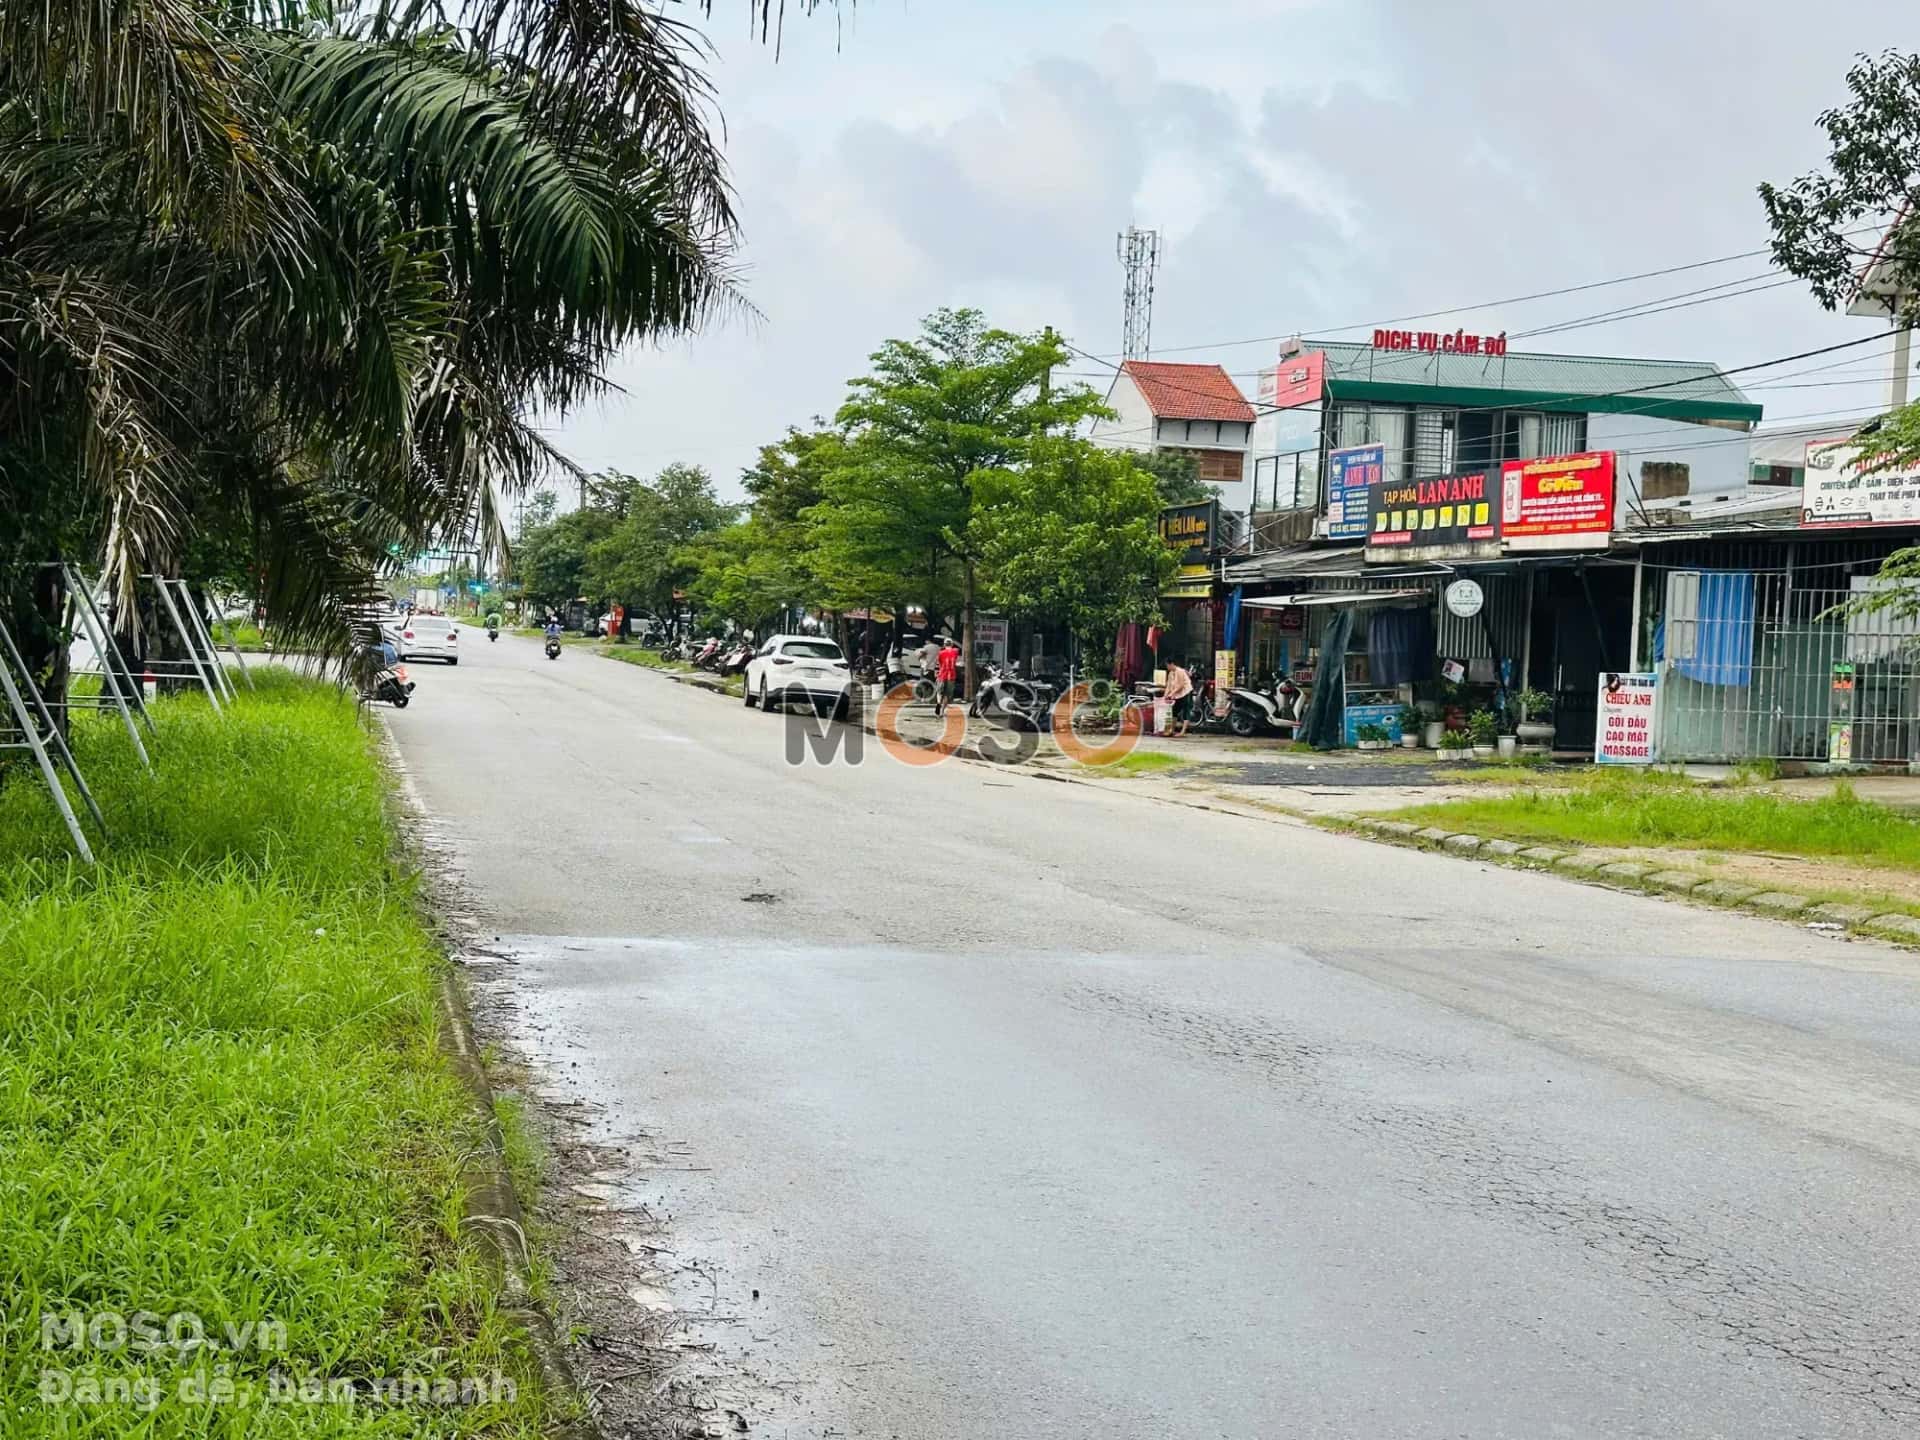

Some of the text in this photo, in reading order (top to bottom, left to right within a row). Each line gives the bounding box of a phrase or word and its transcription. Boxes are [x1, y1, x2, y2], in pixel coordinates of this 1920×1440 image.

[1373, 329, 1412, 353] DỊCH
[1417, 332, 1438, 356] VỤ
[1383, 490, 1399, 508] TẠP
[1417, 479, 1448, 504] LAN
[1450, 474, 1485, 501] ANH
[1633, 693, 1652, 706] ANH
[1606, 730, 1624, 741] CAO
[1603, 745, 1649, 757] MASSAGE
